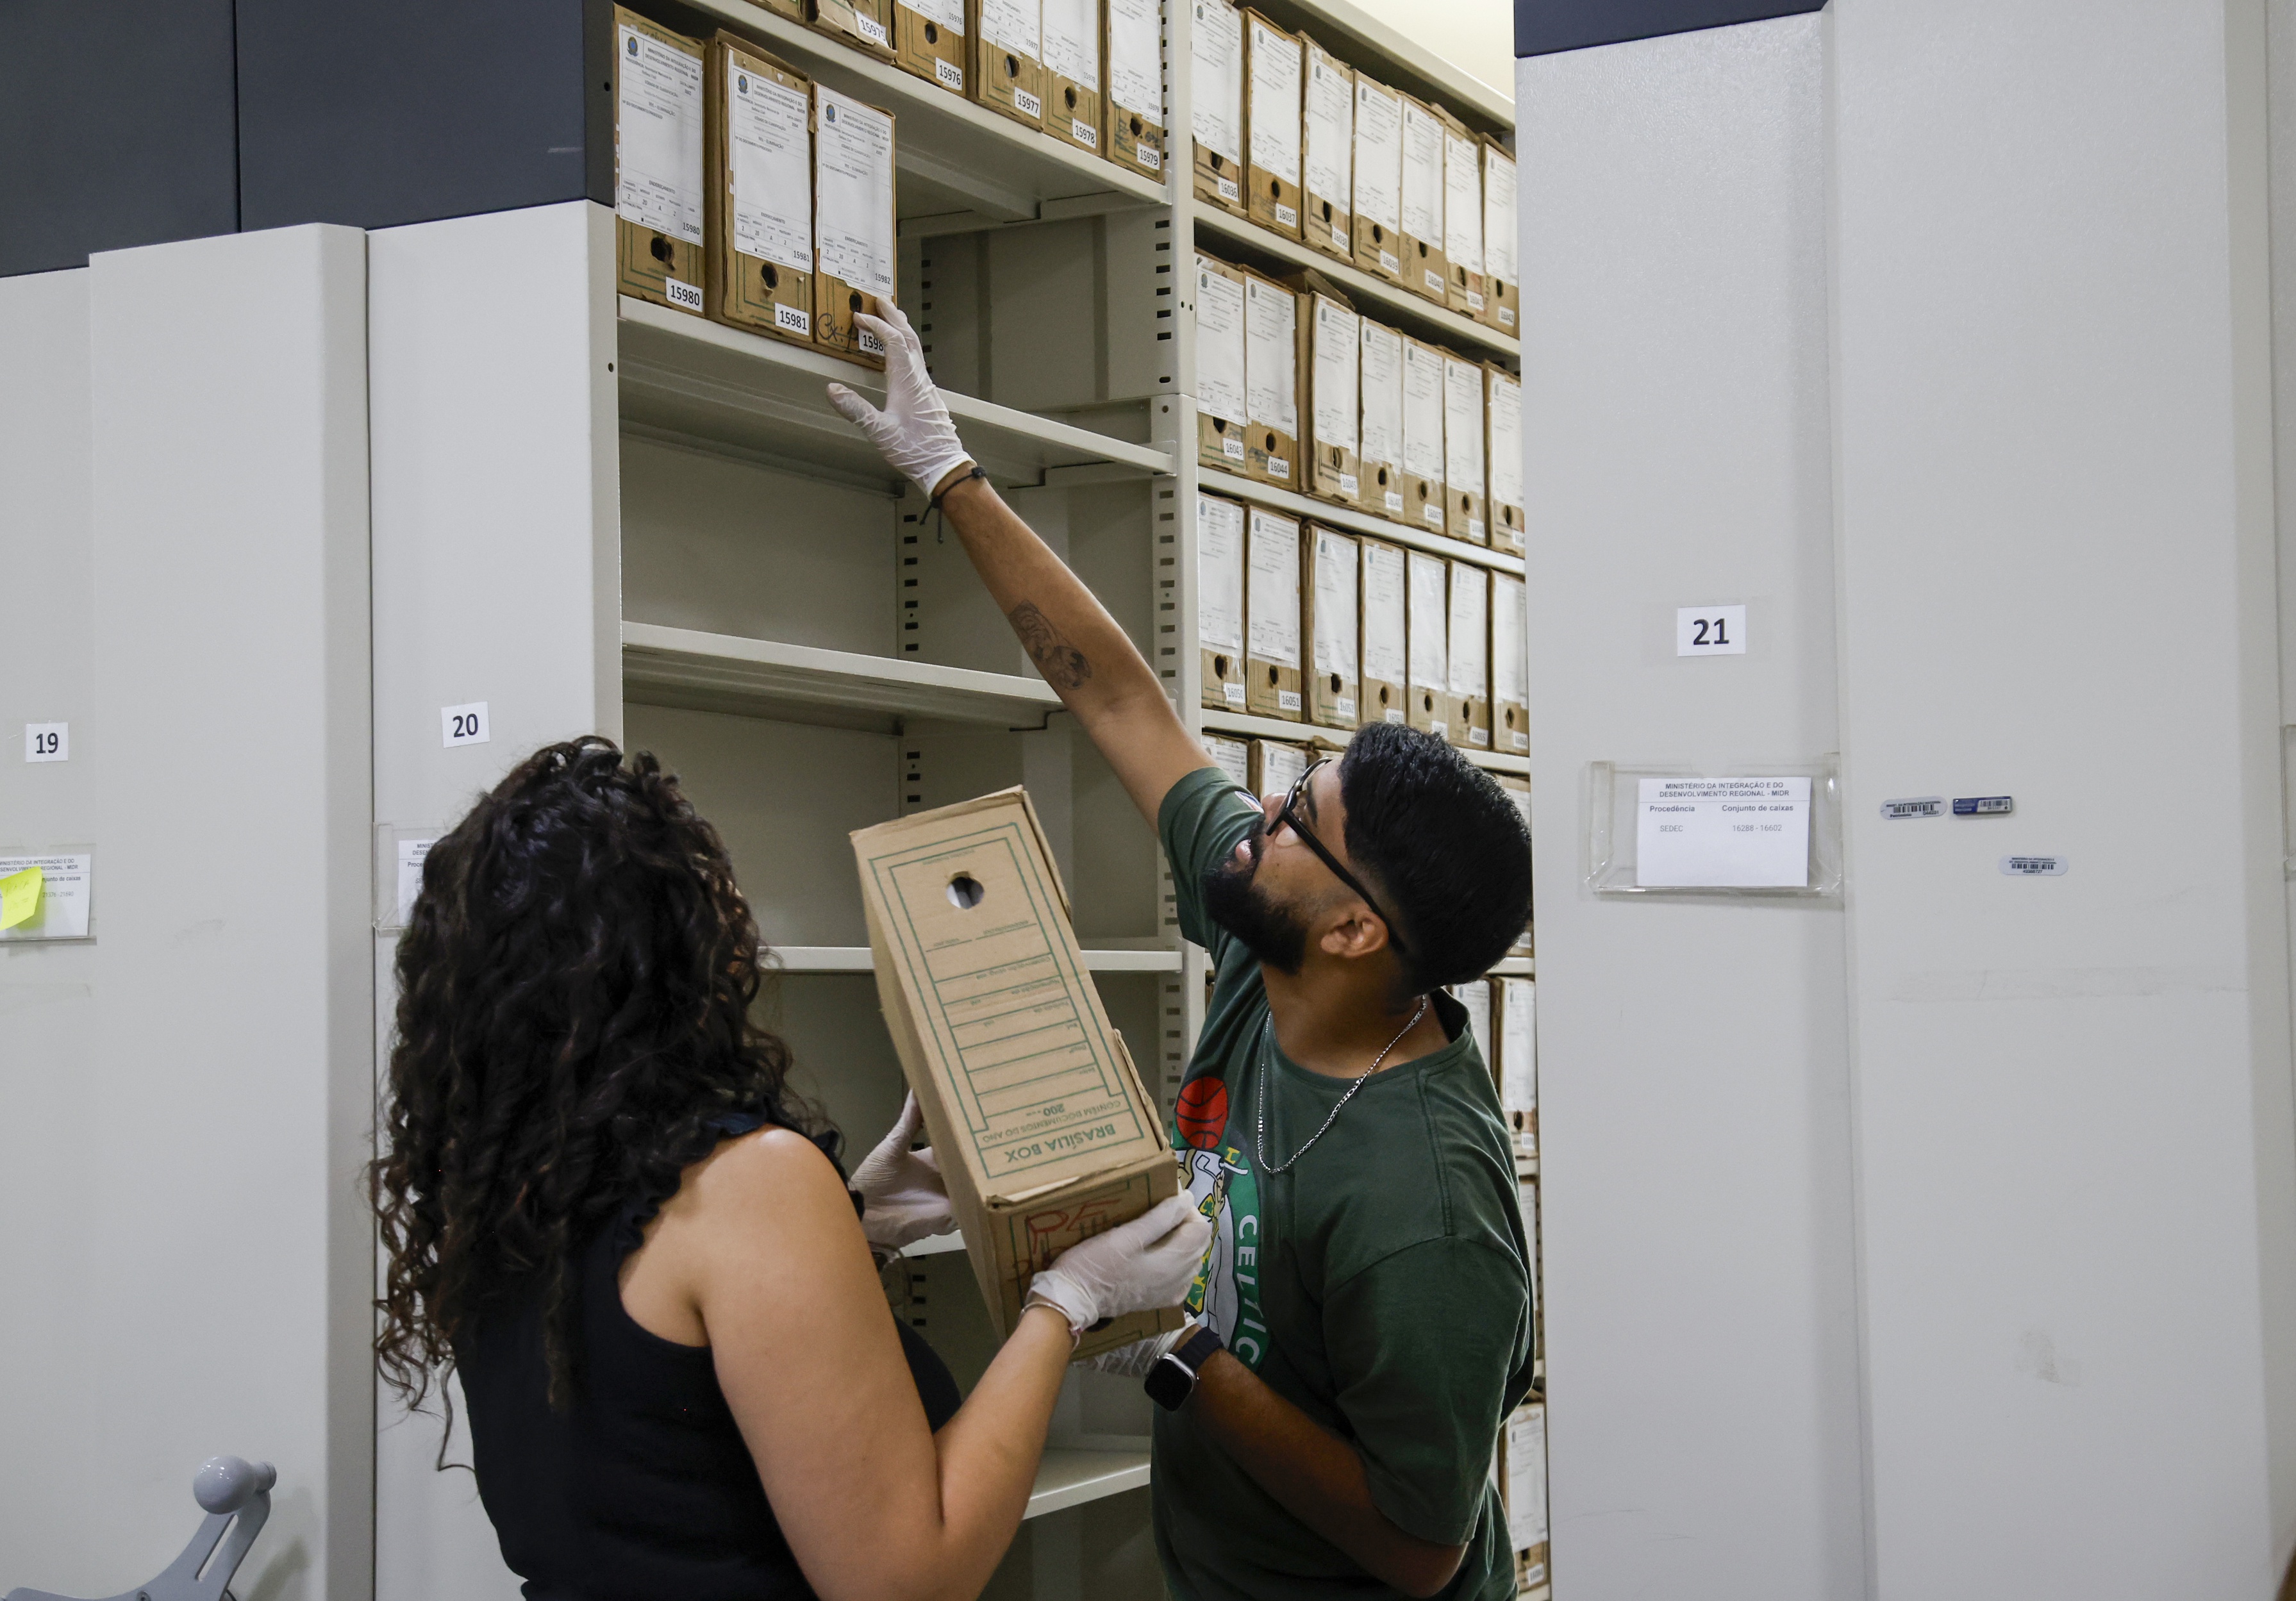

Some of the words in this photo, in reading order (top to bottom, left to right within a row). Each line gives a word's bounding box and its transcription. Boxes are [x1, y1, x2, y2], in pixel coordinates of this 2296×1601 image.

[949, 12, 962, 25] 15976
[861, 19, 886, 42] 15975
[1026, 38, 1038, 51] 15977
[939, 65, 961, 85] 15976
[1018, 94, 1039, 113] 15977
[1076, 125, 1095, 144] 15978
[1140, 149, 1158, 165] 15979
[1221, 183, 1238, 197] 16036
[1279, 209, 1295, 223] 16037
[683, 222, 700, 235] 15980
[794, 250, 810, 262] 15981
[1383, 255, 1399, 270] 16039
[875, 273, 890, 285] 15982
[670, 285, 701, 306] 15980
[780, 310, 808, 331] 15981
[863, 335, 884, 351] 1598
[1226, 443, 1242, 456] 16043
[1270, 461, 1288, 474] 16044
[1693, 618, 1730, 645] 21
[1282, 695, 1300, 707] 16051
[1340, 701, 1354, 713] 16052
[453, 713, 479, 738] 20
[35, 732, 59, 754] 19
[1718, 781, 1765, 790] INTEGRAÇÃO
[1722, 805, 1756, 813] Conjunto
[1084, 1100, 1121, 1115] CONTÉM
[1020, 1109, 1083, 1134] DOCUMENTOS
[982, 1131, 1003, 1143] ANO
[1005, 1128, 1020, 1136] DO
[1044, 1124, 1116, 1151] BRASÍLIA
[1004, 1143, 1043, 1163] BOX
[1235, 1215, 1268, 1365] CELTIC
